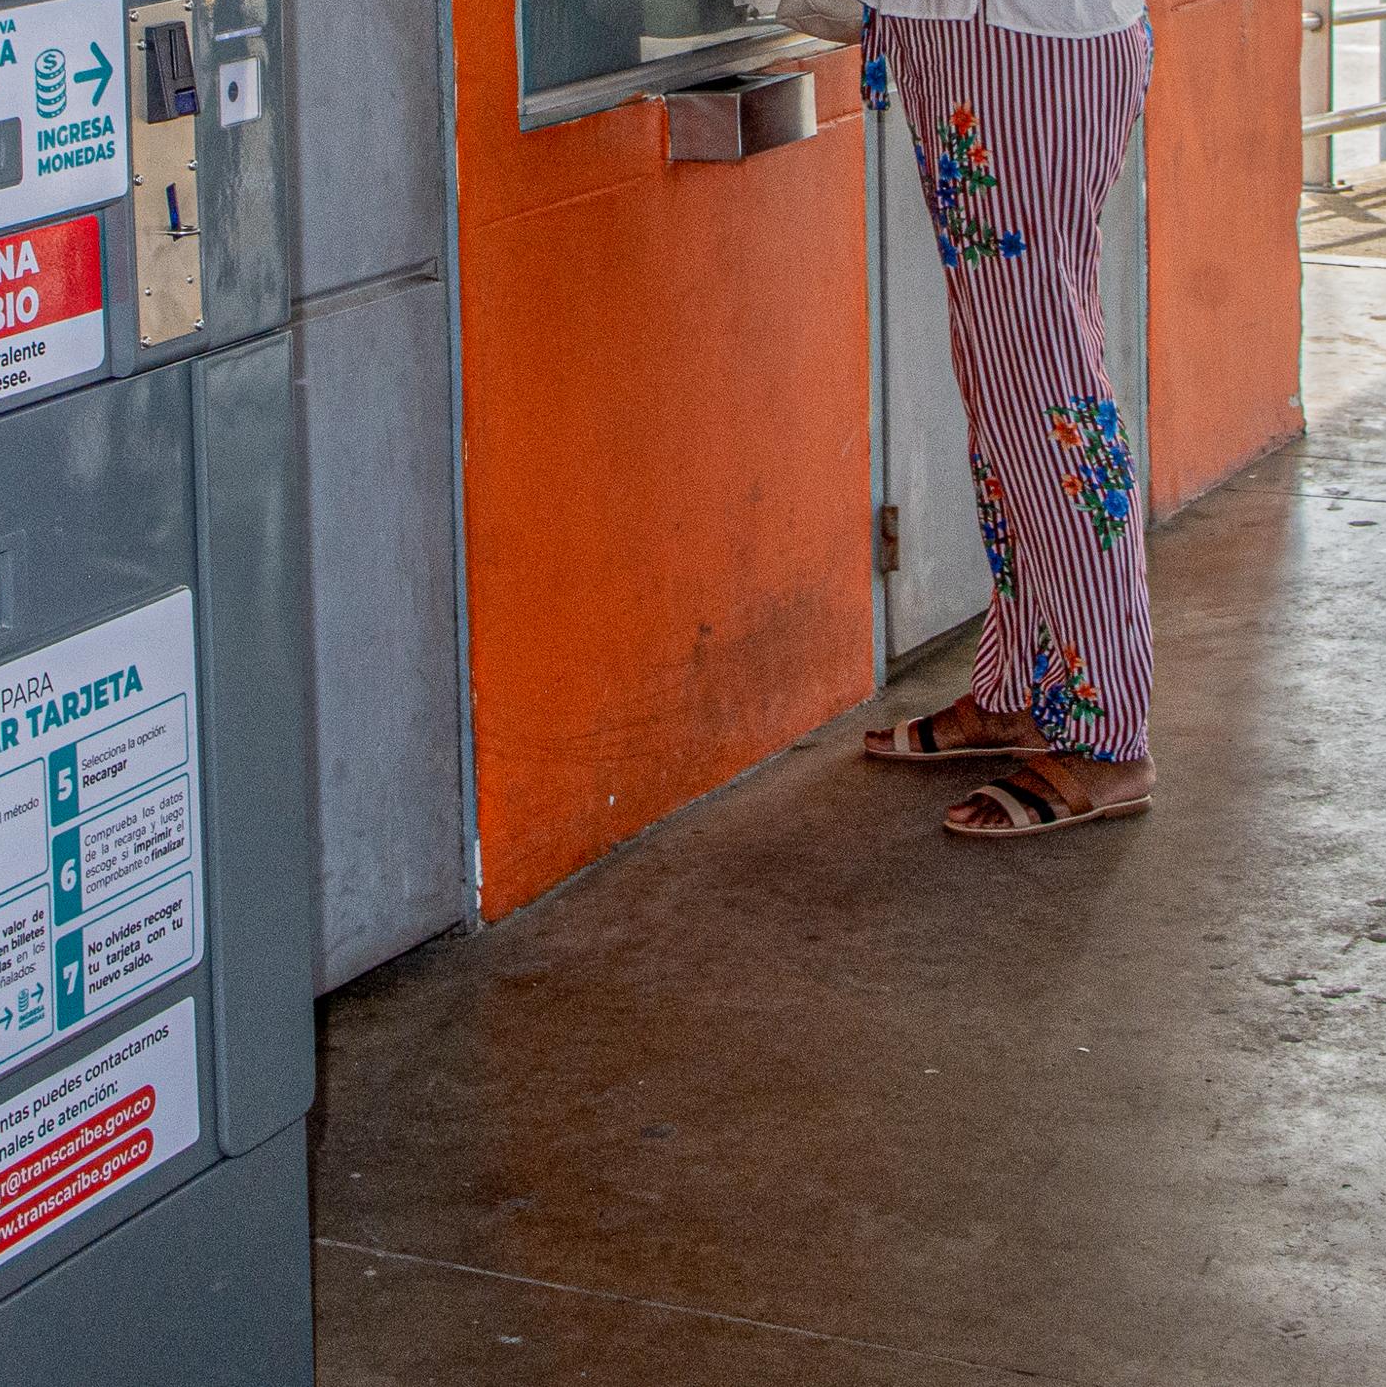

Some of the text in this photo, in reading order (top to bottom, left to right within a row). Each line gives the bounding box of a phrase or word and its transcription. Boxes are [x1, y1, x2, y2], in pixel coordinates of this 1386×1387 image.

[37, 115, 115, 151] INGRESA
[38, 140, 116, 176] MONEDAS
[1, 671, 54, 713] PARA
[26, 664, 143, 739] TARJETA
[57, 724, 167, 802] 5 Selecciona opción:
[82, 759, 128, 788] Recargar
[4, 797, 40, 822] método
[85, 806, 184, 863] de recarga luego
[60, 791, 184, 892] 6 Comprueba los datos
[85, 826, 172, 879] escoge imprimir
[85, 837, 185, 894] comprobante finalizar
[2, 917, 27, 939] valor
[32, 910, 45, 923] de
[11, 925, 45, 950] billetes
[63, 899, 182, 996] 7 No olvides recoger
[88, 917, 183, 975] tu tarjeta con tu
[16, 950, 28, 964] en
[32, 941, 46, 956] los
[89, 952, 154, 994] nuevo saldo.
[33, 1074, 82, 1119] puedes
[85, 1024, 169, 1083] contactarnos
[37, 1118, 55, 1138] de
[57, 1079, 119, 1126] atención:
